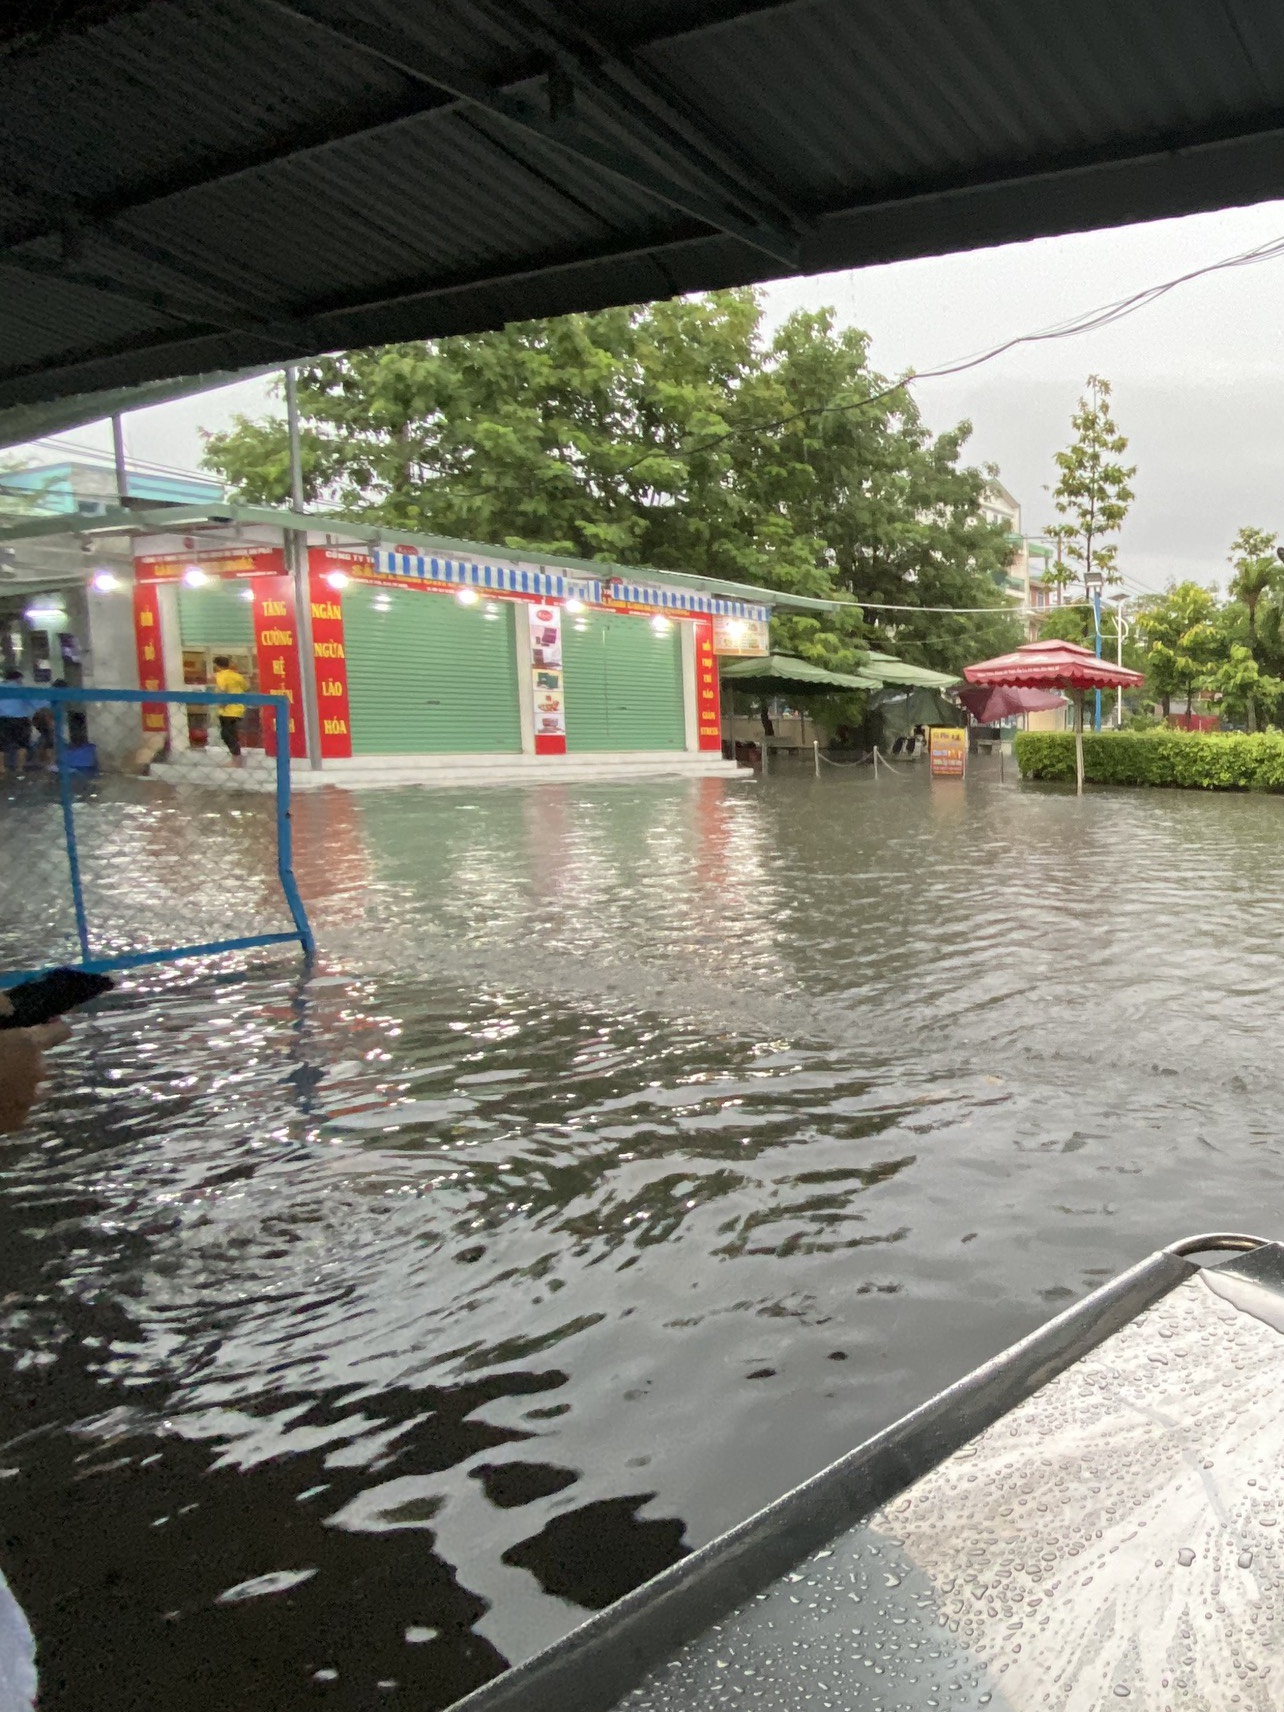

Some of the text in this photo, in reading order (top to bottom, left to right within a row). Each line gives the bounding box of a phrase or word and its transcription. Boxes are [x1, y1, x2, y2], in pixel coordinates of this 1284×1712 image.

[262, 597, 287, 616] TĂNG
[311, 600, 342, 620] NGĂN
[261, 627, 293, 646] CƯỜNG
[313, 639, 345, 658] NGỪA
[272, 656, 286, 678] HỆ
[322, 678, 342, 697] LÃO
[324, 715, 348, 735] HÓA
